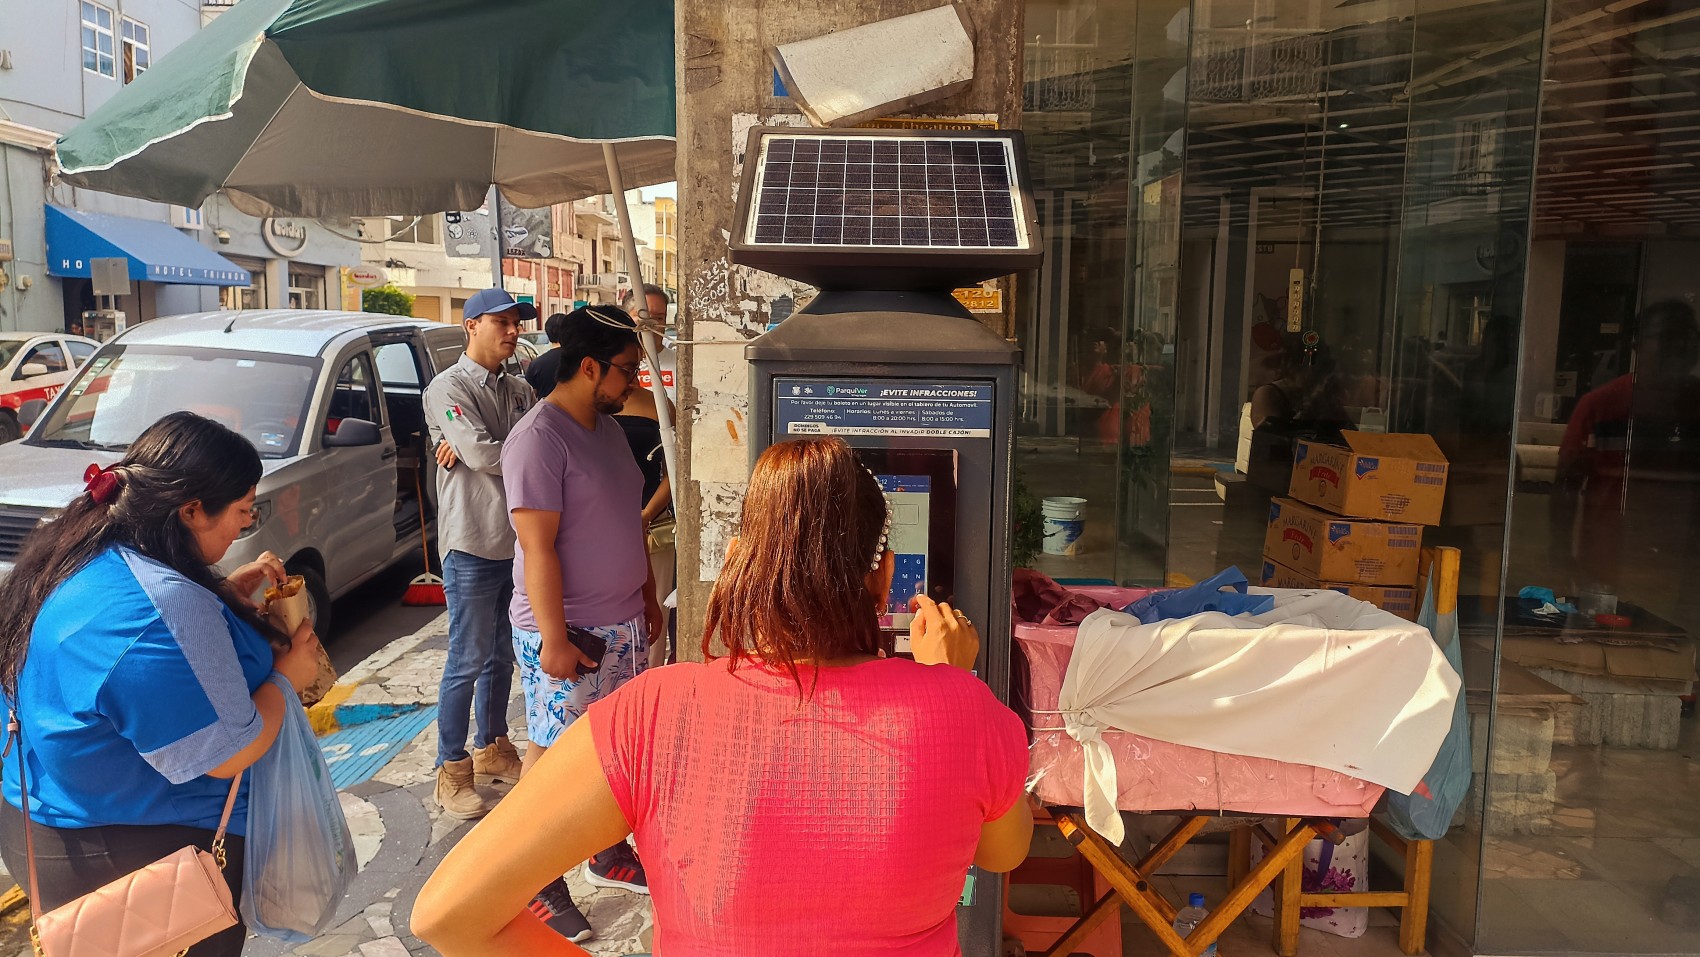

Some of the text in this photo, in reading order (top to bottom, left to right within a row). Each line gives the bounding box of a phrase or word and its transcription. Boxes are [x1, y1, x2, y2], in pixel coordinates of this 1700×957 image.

[155, 265, 246, 281] HOTEL TRIANON
[880, 389, 978, 398] ¡EVITE INFRACCIONES!
